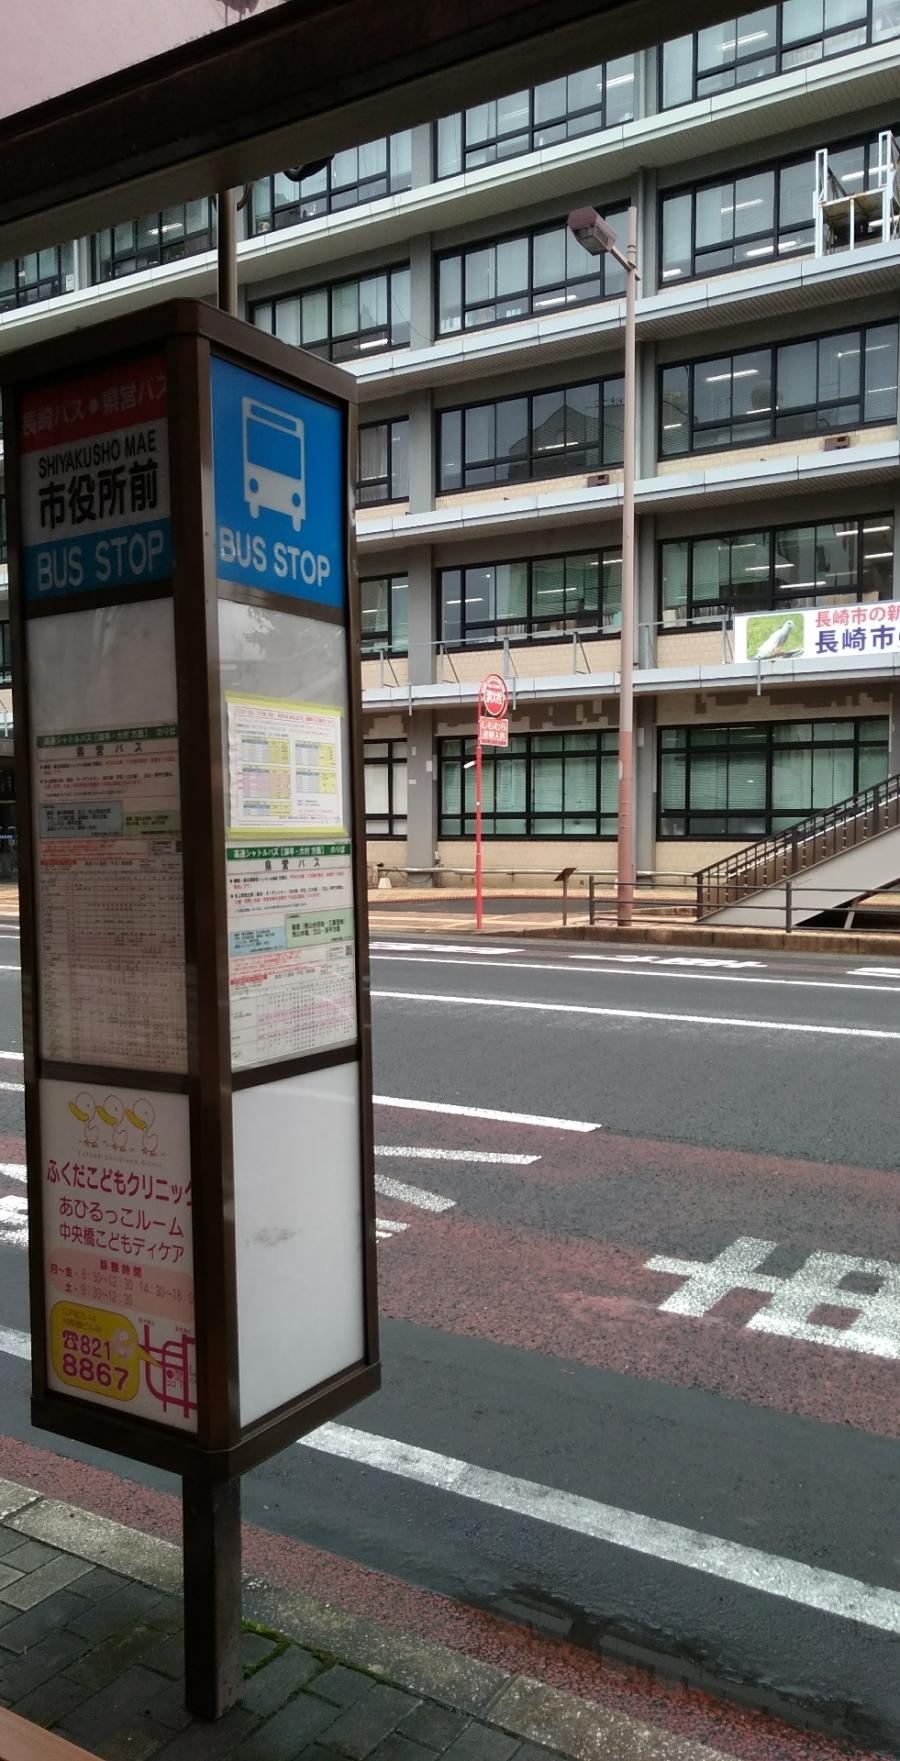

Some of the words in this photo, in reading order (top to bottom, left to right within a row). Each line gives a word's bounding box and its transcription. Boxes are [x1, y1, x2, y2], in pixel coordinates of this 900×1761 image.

[38, 439, 121, 479] SHIYAKUSHO
[125, 430, 156, 457] MAE
[39, 458, 158, 529] 市役所前
[38, 545, 83, 591] BUS
[96, 529, 164, 581] STOP
[220, 527, 267, 572] BUS
[273, 542, 331, 587] STOP
[815, 604, 900, 628] 長崎市の新
[815, 625, 900, 654] 長崎市
[59, 1196, 184, 1237] あひるっこルーム
[80, 1334, 111, 1360] 821
[62, 1352, 129, 1391] 8867
